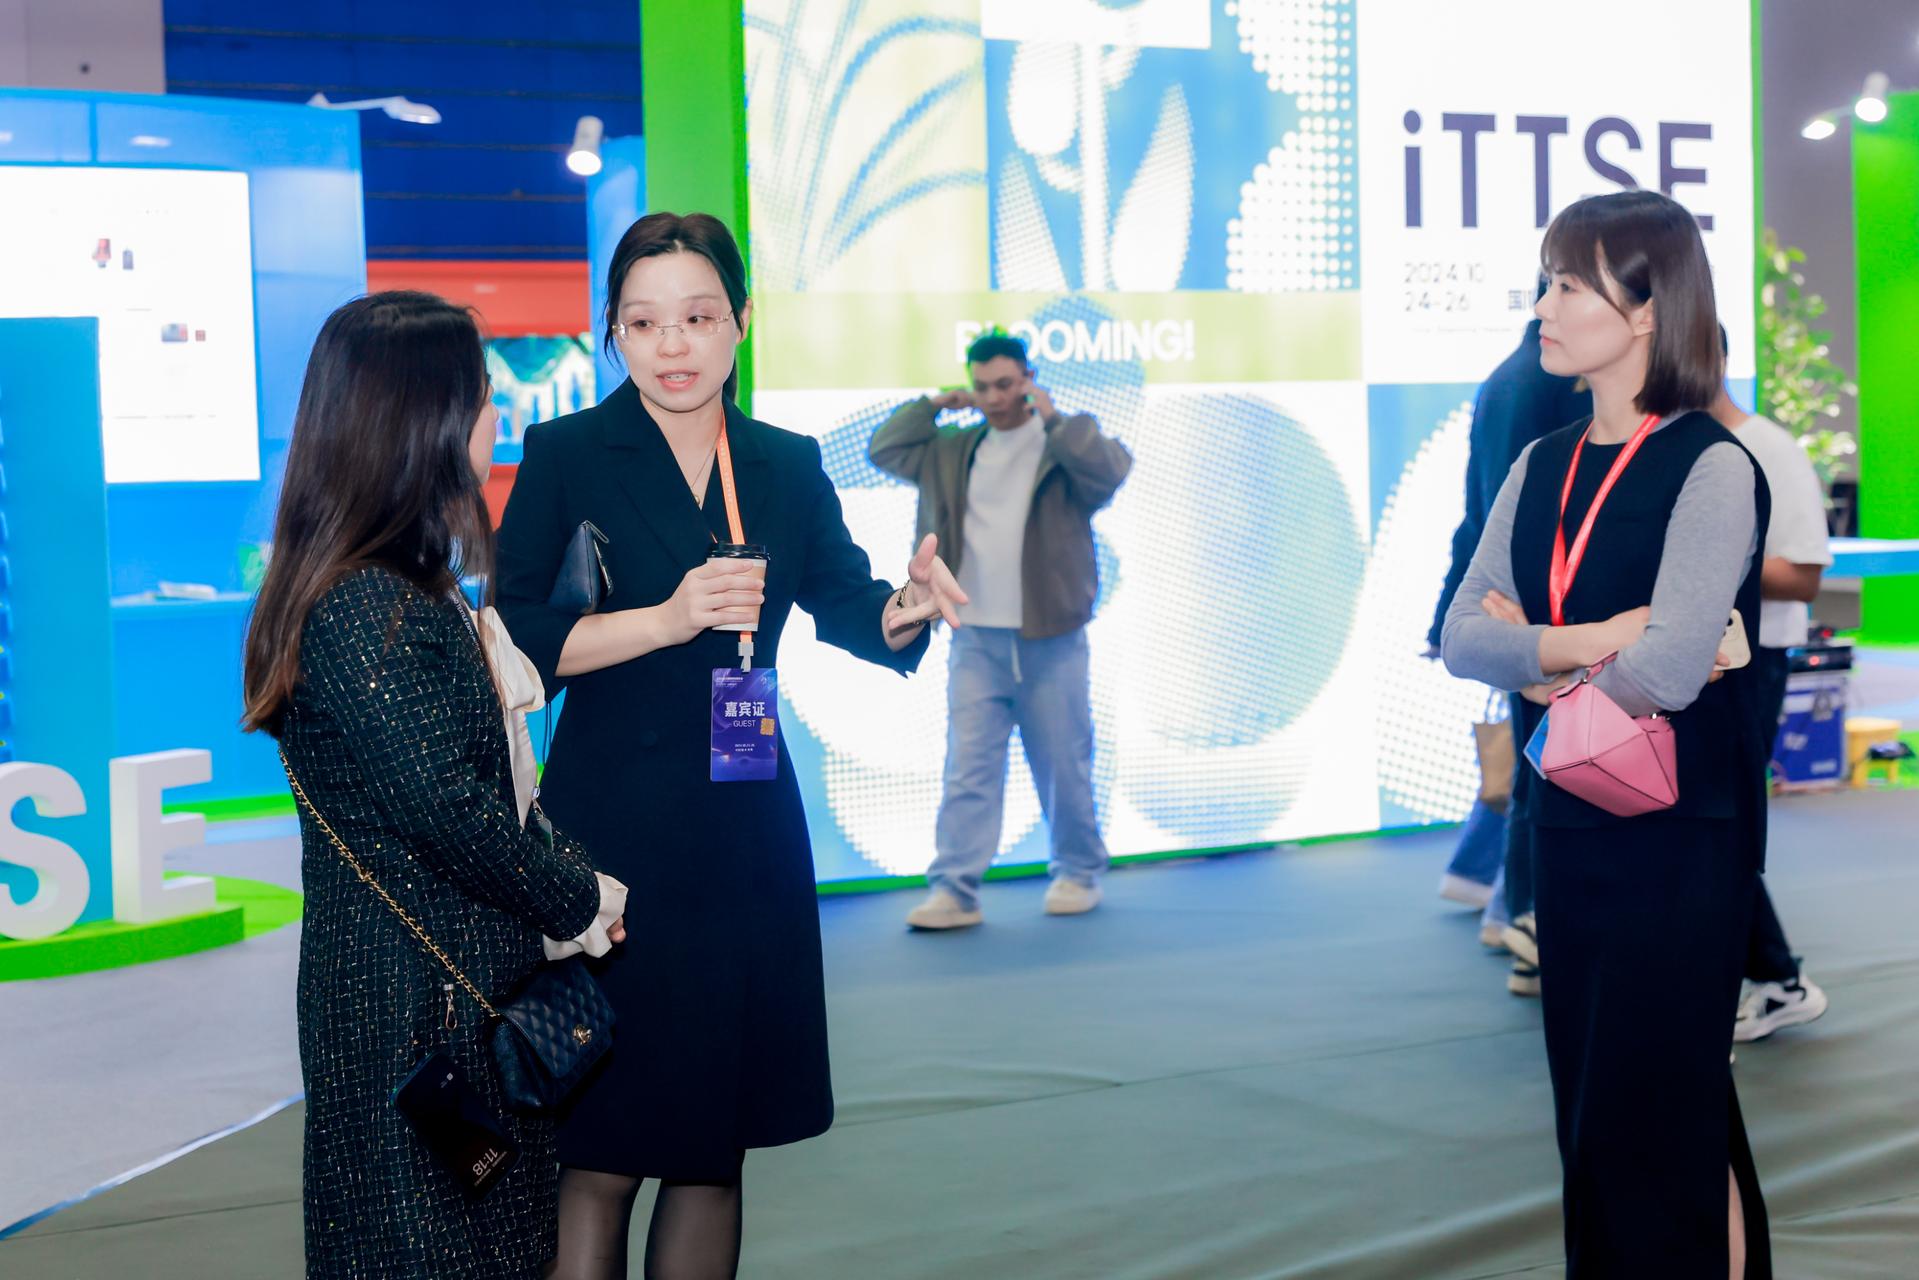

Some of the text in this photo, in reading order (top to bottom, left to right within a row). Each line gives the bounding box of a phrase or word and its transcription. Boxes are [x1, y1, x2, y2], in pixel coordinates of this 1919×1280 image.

[955, 319, 1195, 364] BOOMING!
[724, 701, 766, 717] 嘉宾证
[733, 720, 756, 728] GUEST
[472, 1148, 498, 1176] 11:18
